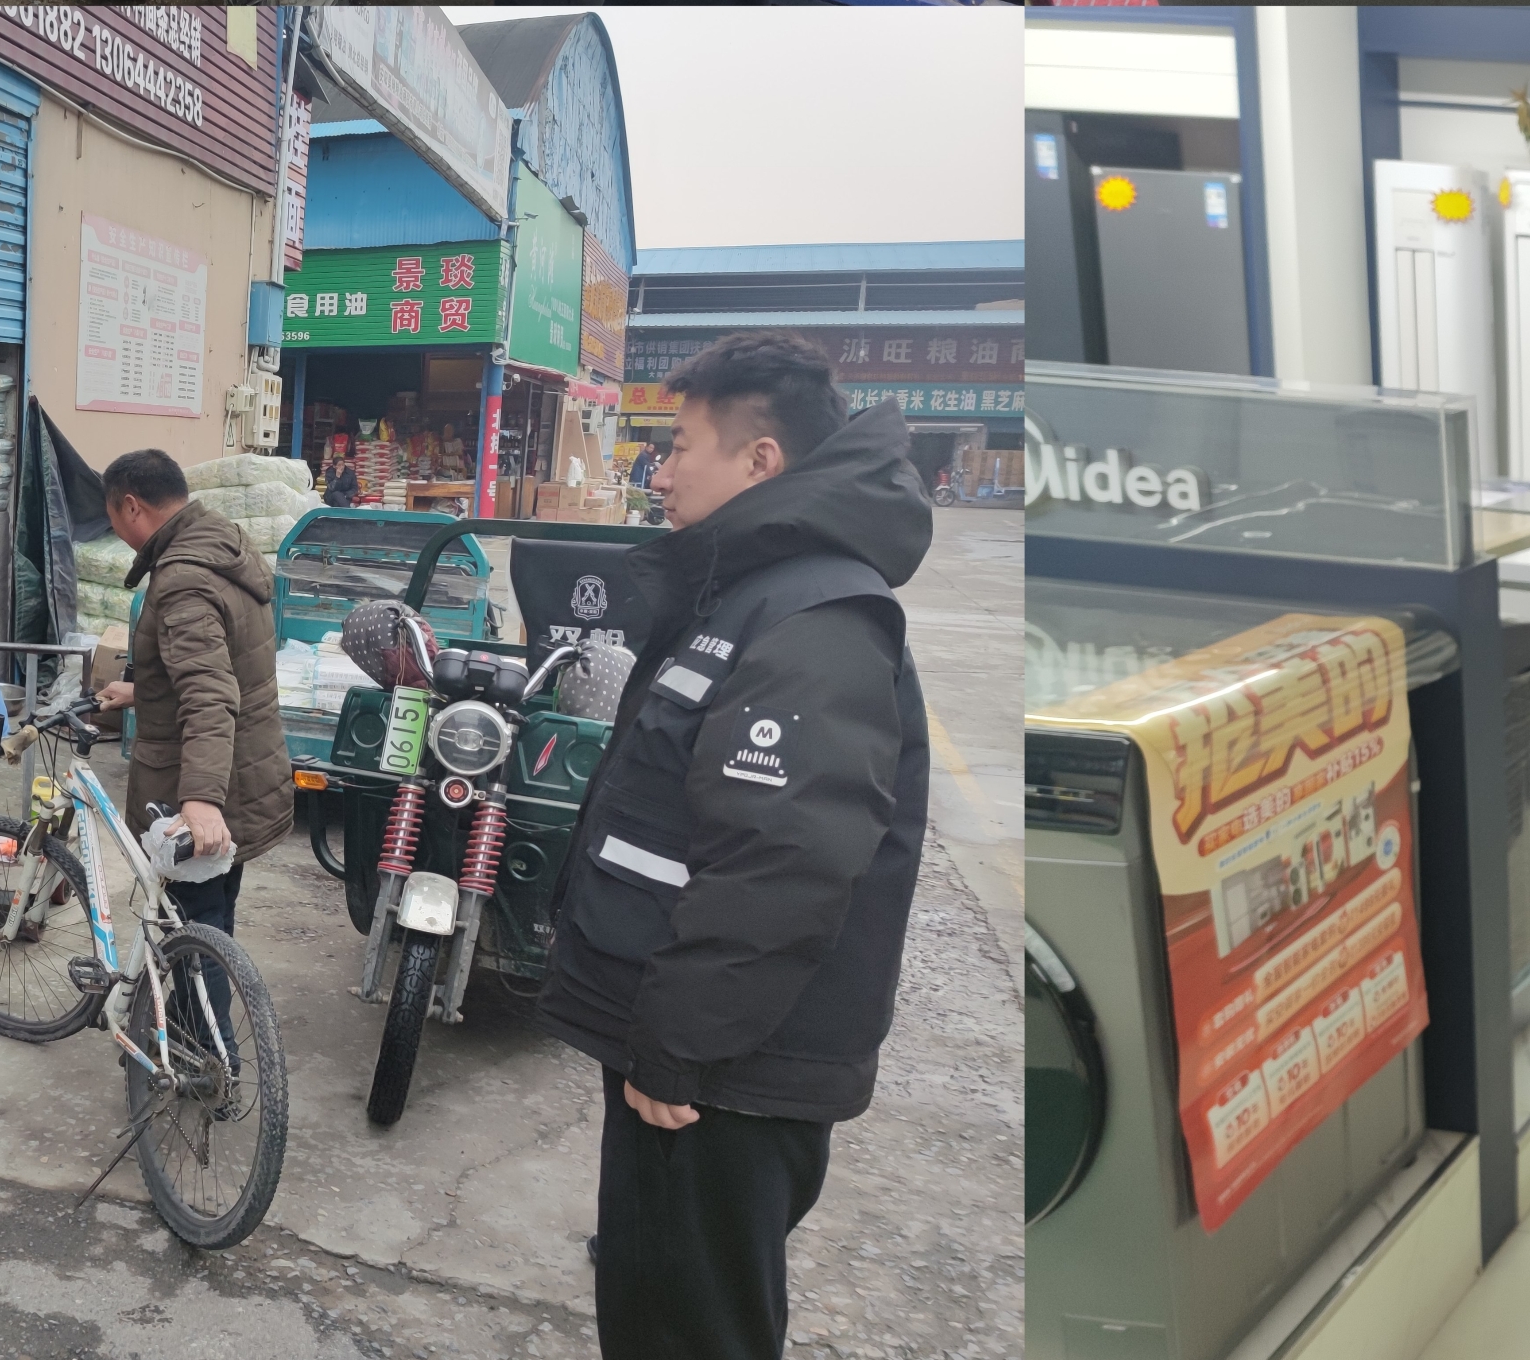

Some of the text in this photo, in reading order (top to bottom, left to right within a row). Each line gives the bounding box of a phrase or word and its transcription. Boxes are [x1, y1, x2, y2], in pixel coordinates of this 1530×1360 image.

[91, 23, 204, 128] 13064442358
[286, 291, 369, 318] 食用油
[390, 297, 473, 334] 商贸
[929, 389, 978, 412] 花生油
[754, 725, 774, 740] M
